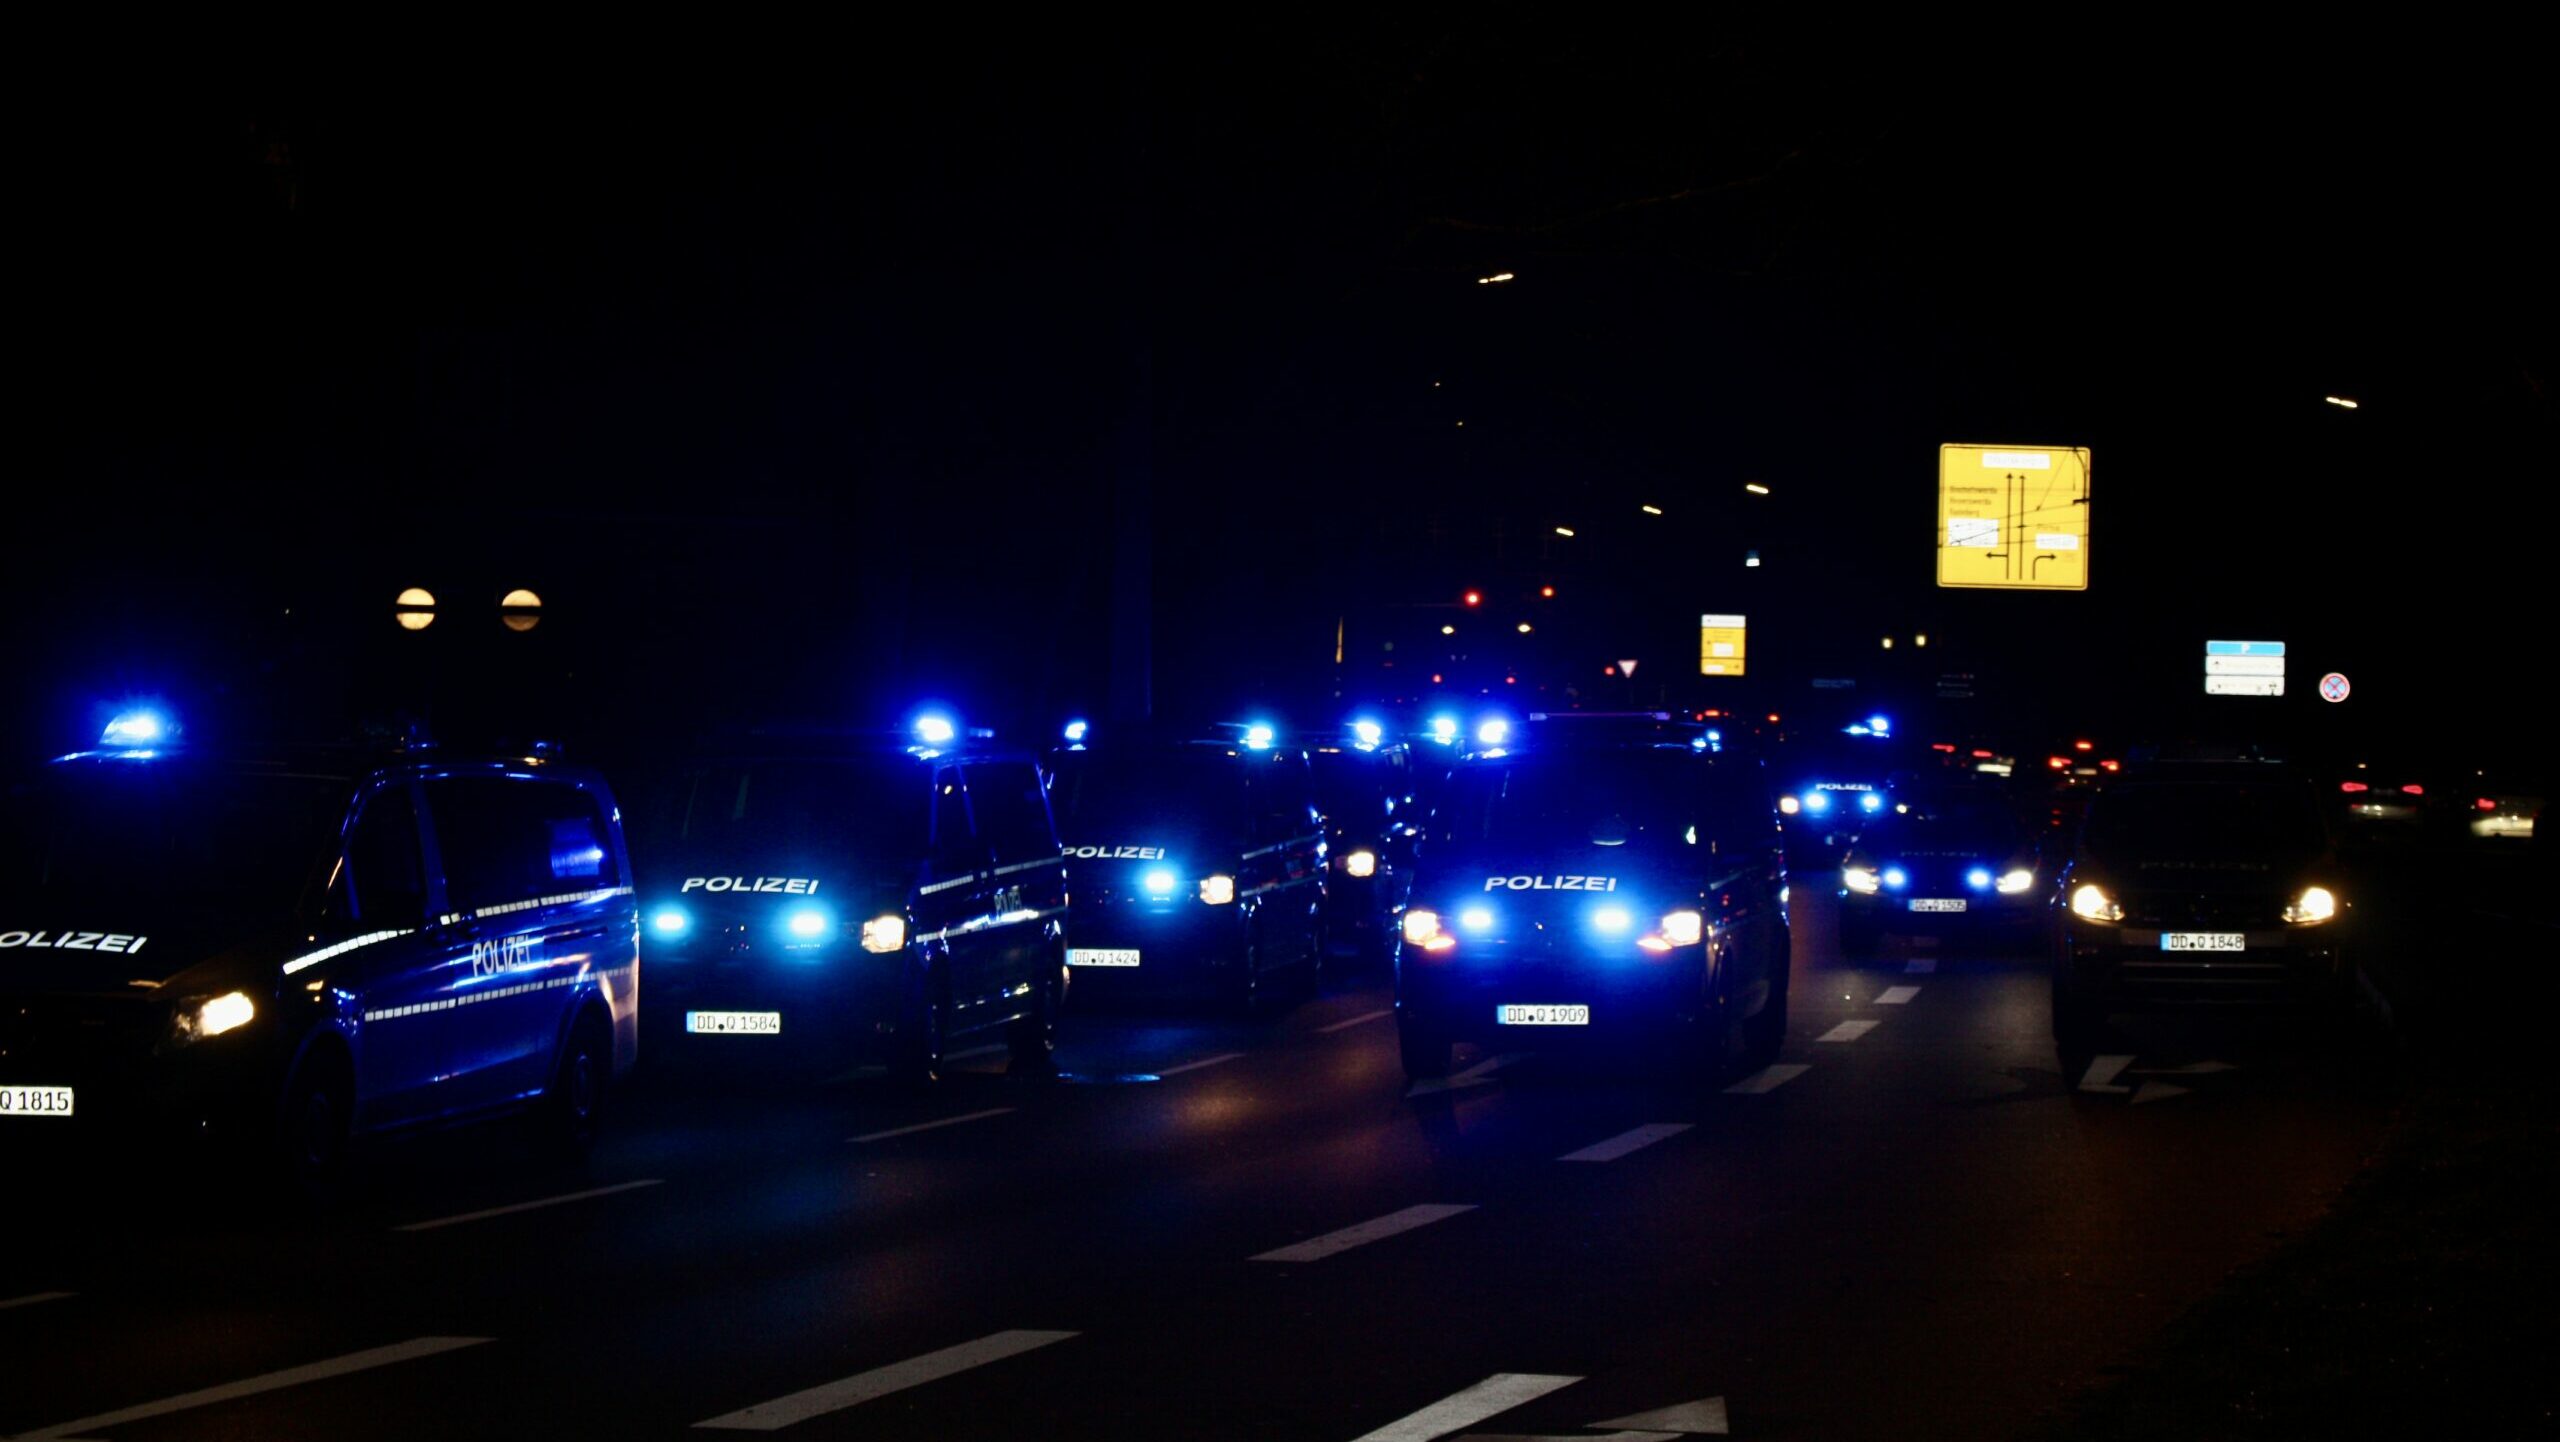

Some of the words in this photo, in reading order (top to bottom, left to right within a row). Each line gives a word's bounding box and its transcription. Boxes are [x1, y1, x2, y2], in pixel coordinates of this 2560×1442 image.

[1815, 782, 1873, 791] POLIZEI
[1061, 846, 1165, 860] POLIZEI
[681, 877, 819, 895] POLIZEI
[1484, 875, 1617, 892] POLIZEI
[472, 934, 530, 977] POLIZEI
[1550, 1008, 1586, 1022] 1909
[740, 1016, 777, 1030] 1584
[18, 1091, 69, 1111] 1815
